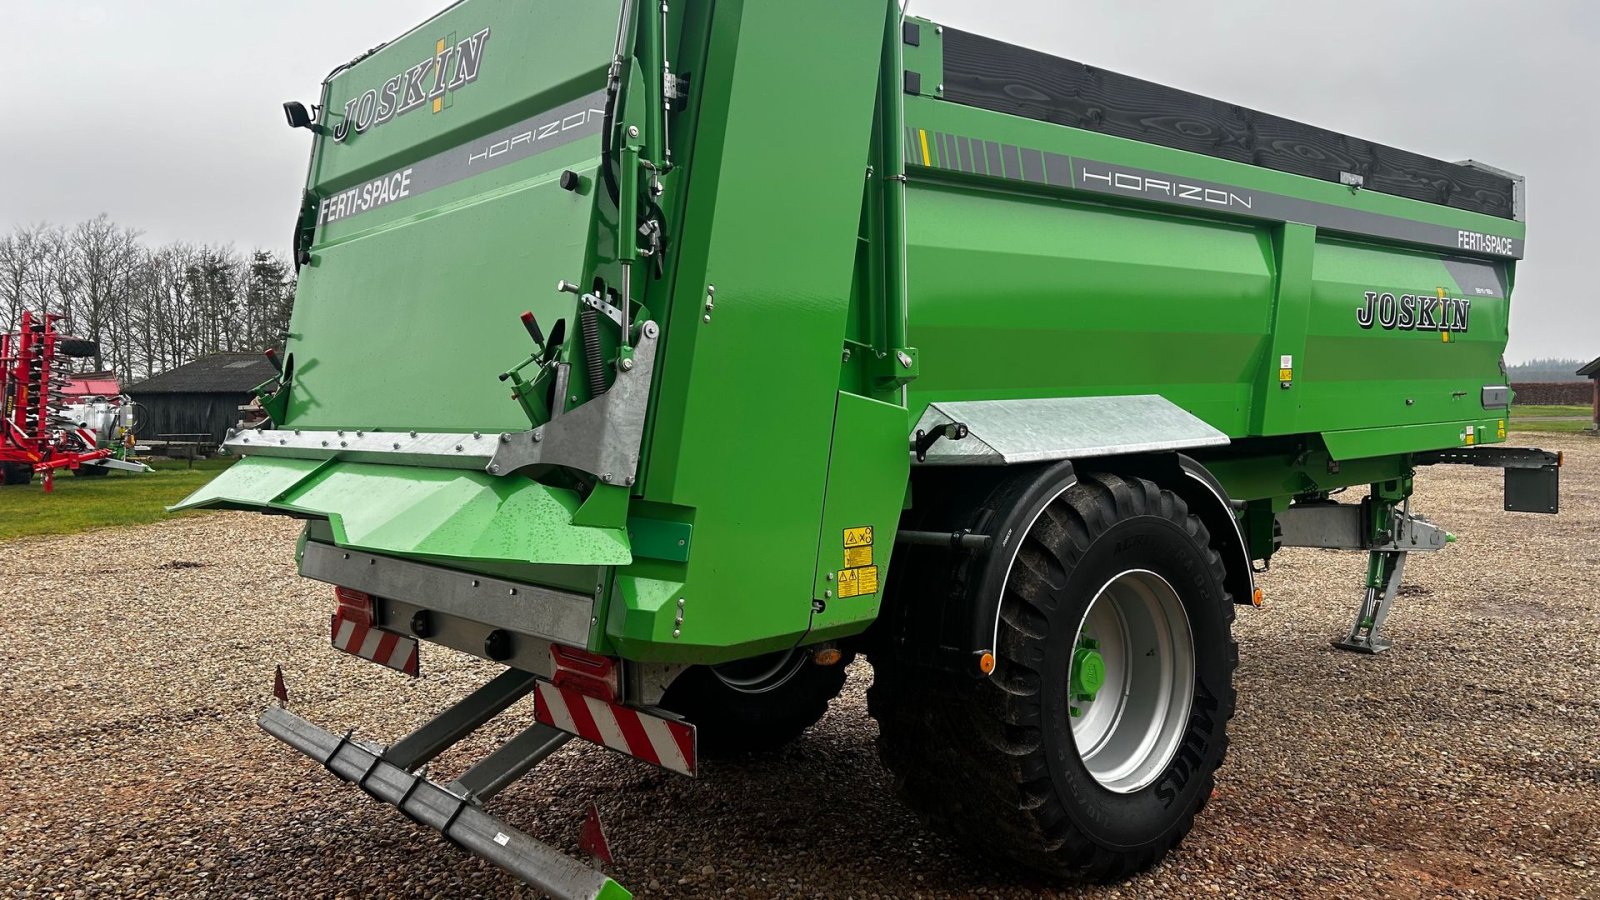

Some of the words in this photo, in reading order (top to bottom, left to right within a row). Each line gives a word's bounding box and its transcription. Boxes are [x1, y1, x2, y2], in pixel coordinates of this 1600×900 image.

[332, 27, 490, 144] JOSKIN
[468, 108, 605, 165] HORIZON
[319, 168, 412, 225] FERTI-SPACE
[1082, 168, 1252, 208] HORIZON
[1457, 230, 1513, 256] FERTI-SPACE
[1357, 291, 1470, 333] JOSKIN
[1155, 675, 1218, 809] Mitas
